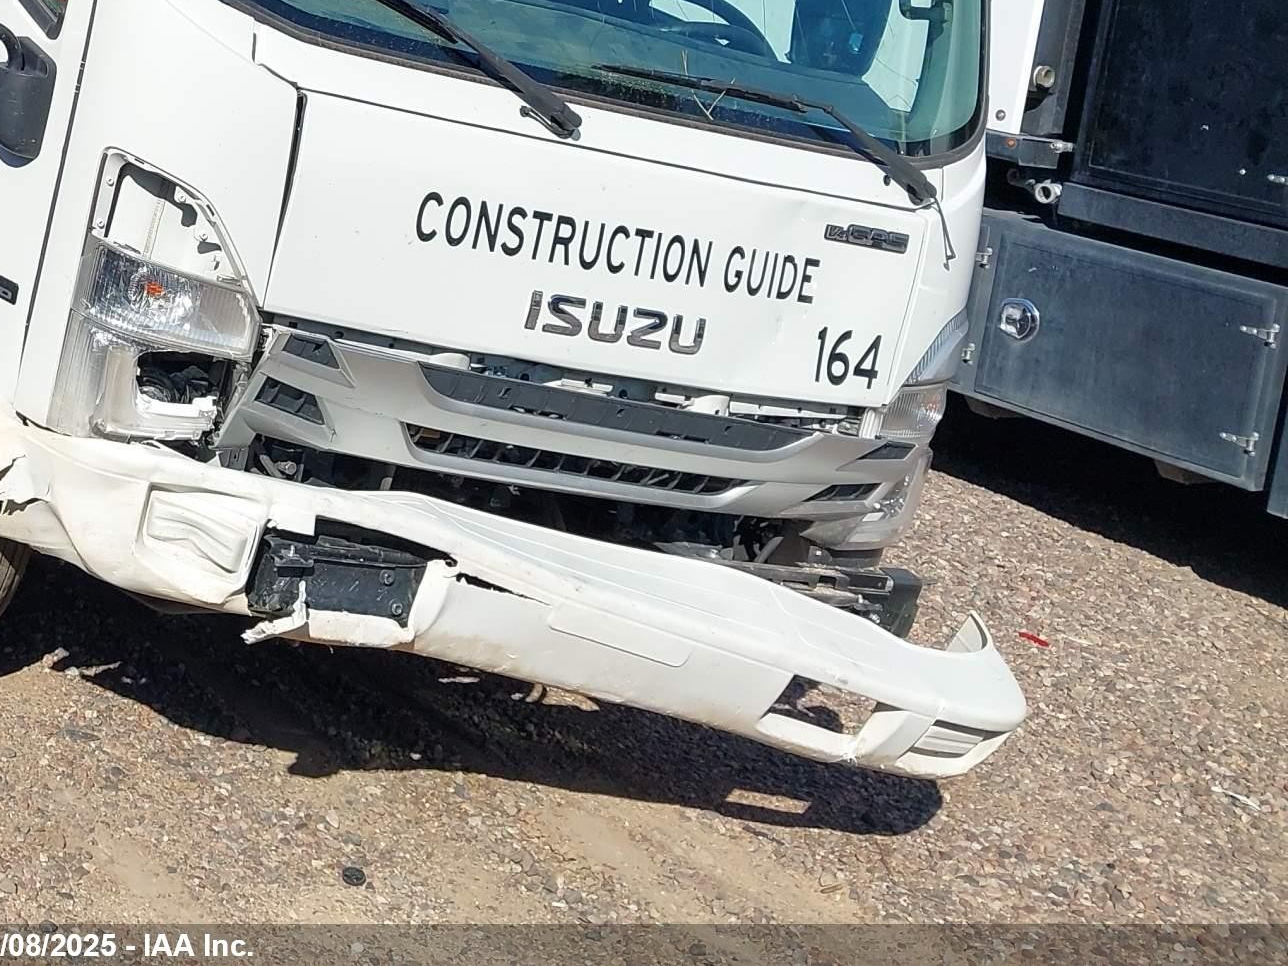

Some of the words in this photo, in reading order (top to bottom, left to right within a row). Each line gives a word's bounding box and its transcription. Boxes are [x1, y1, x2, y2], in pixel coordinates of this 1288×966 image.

[415, 191, 713, 288] CONSTRUCTION
[723, 245, 820, 304] GUIDE
[524, 289, 706, 356] ISUZU
[815, 326, 882, 389] 164
